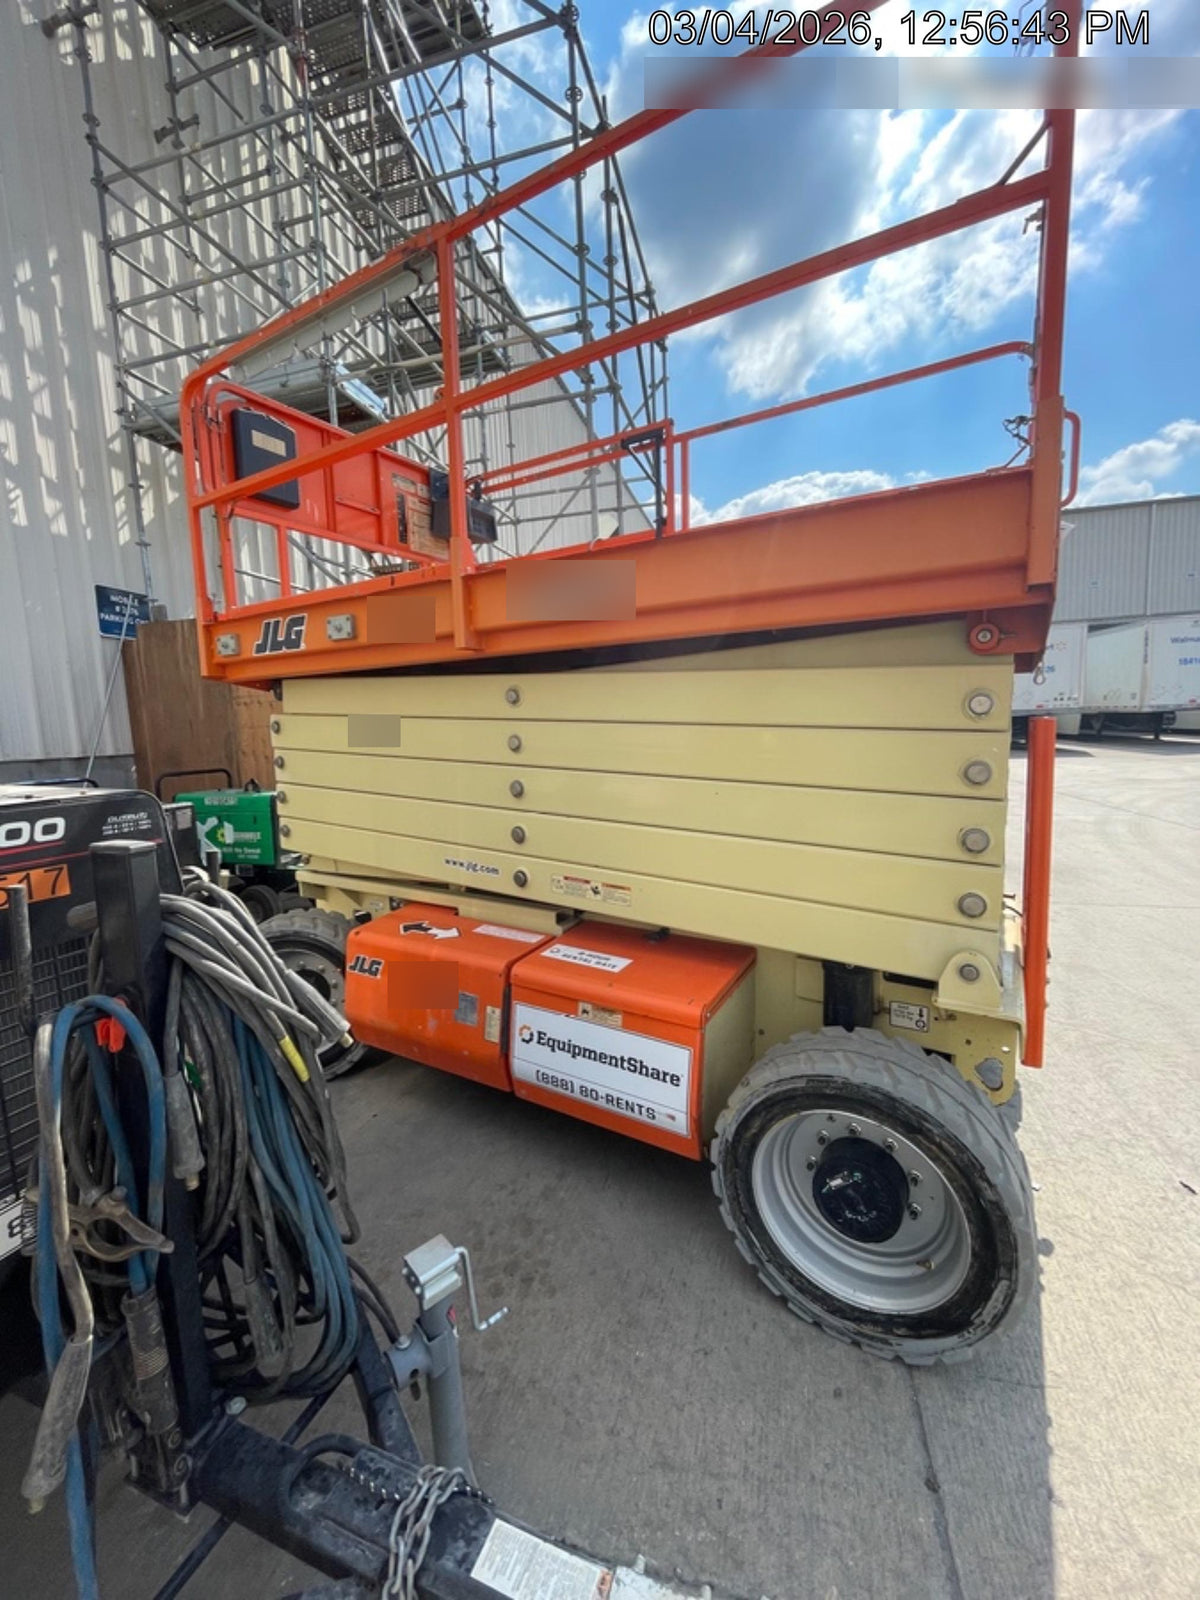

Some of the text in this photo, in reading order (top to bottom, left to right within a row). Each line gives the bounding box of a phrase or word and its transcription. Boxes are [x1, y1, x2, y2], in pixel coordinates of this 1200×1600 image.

[254, 614, 307, 655] JLG
[348, 956, 384, 978] JLG
[535, 1030, 682, 1087] EquipmentShare
[535, 1069, 657, 1121] (888) 80-RENTS
